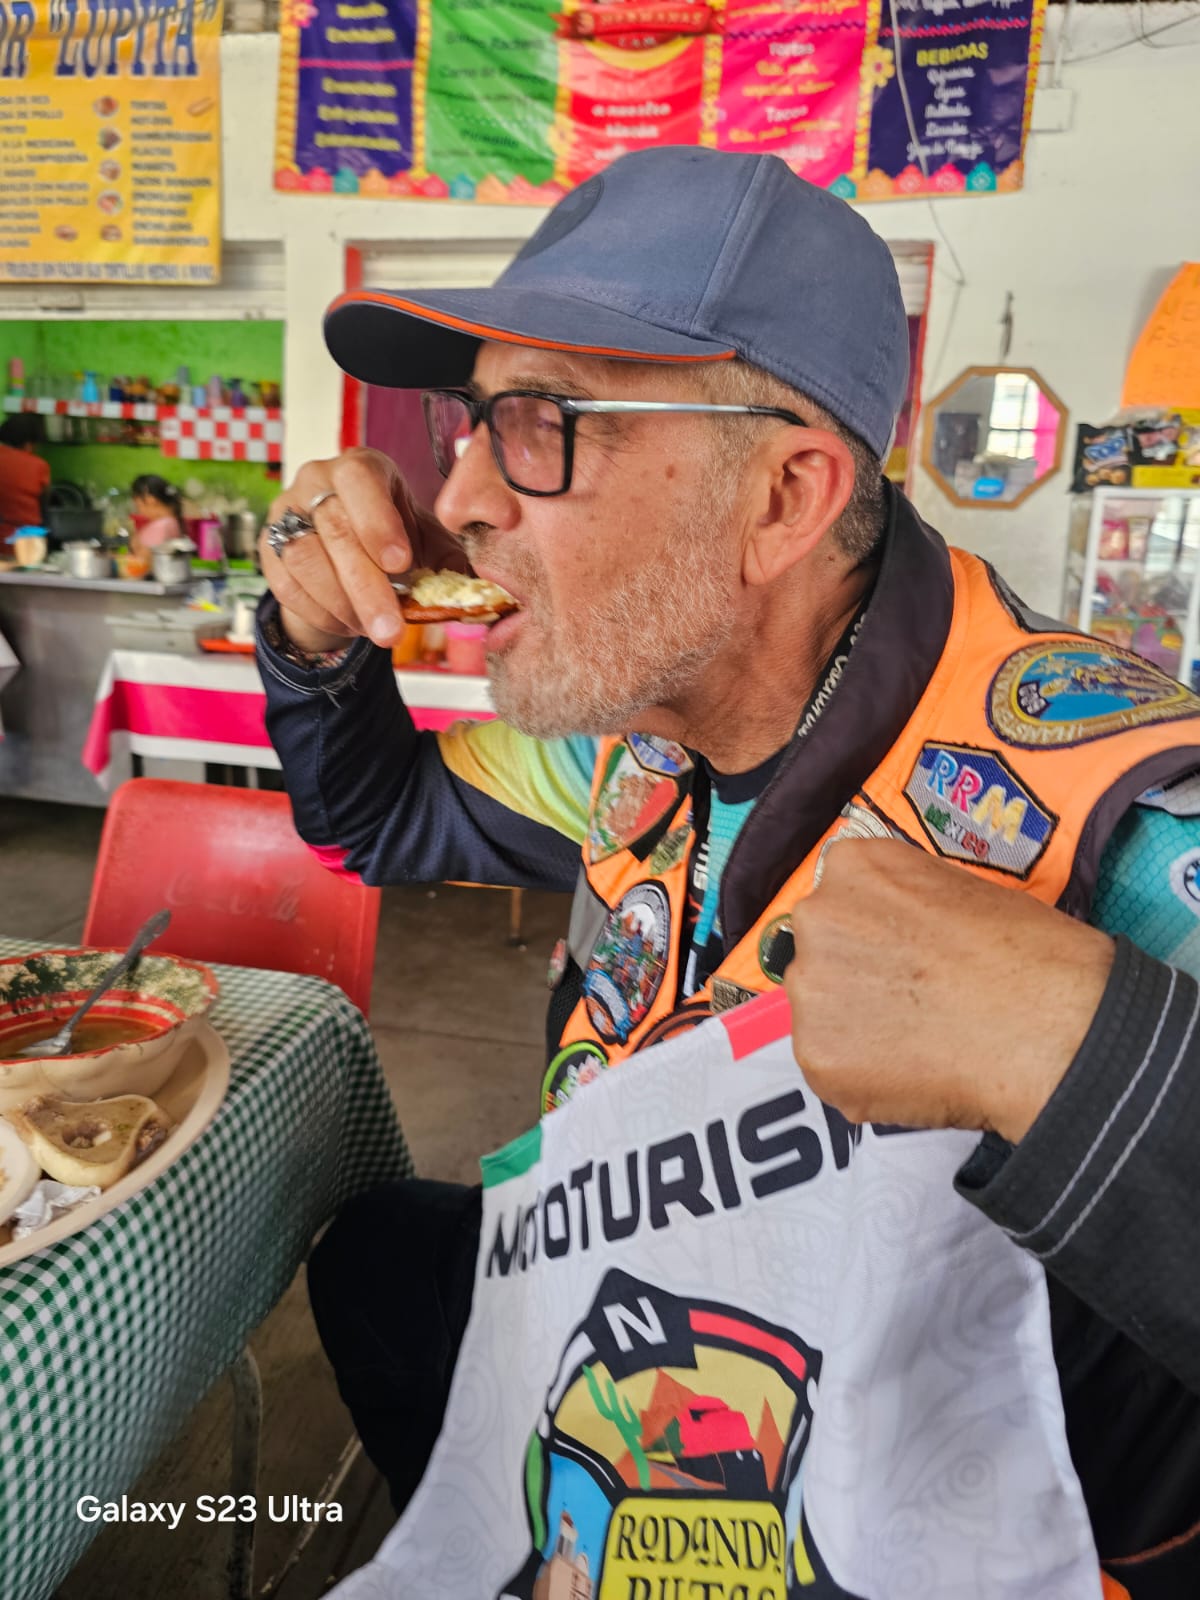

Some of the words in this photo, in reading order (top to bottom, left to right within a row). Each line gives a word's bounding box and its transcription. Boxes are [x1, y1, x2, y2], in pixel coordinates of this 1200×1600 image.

[916, 42, 988, 67] BEBIDAS
[926, 749, 1029, 846] RRM
[602, 1296, 668, 1353] N
